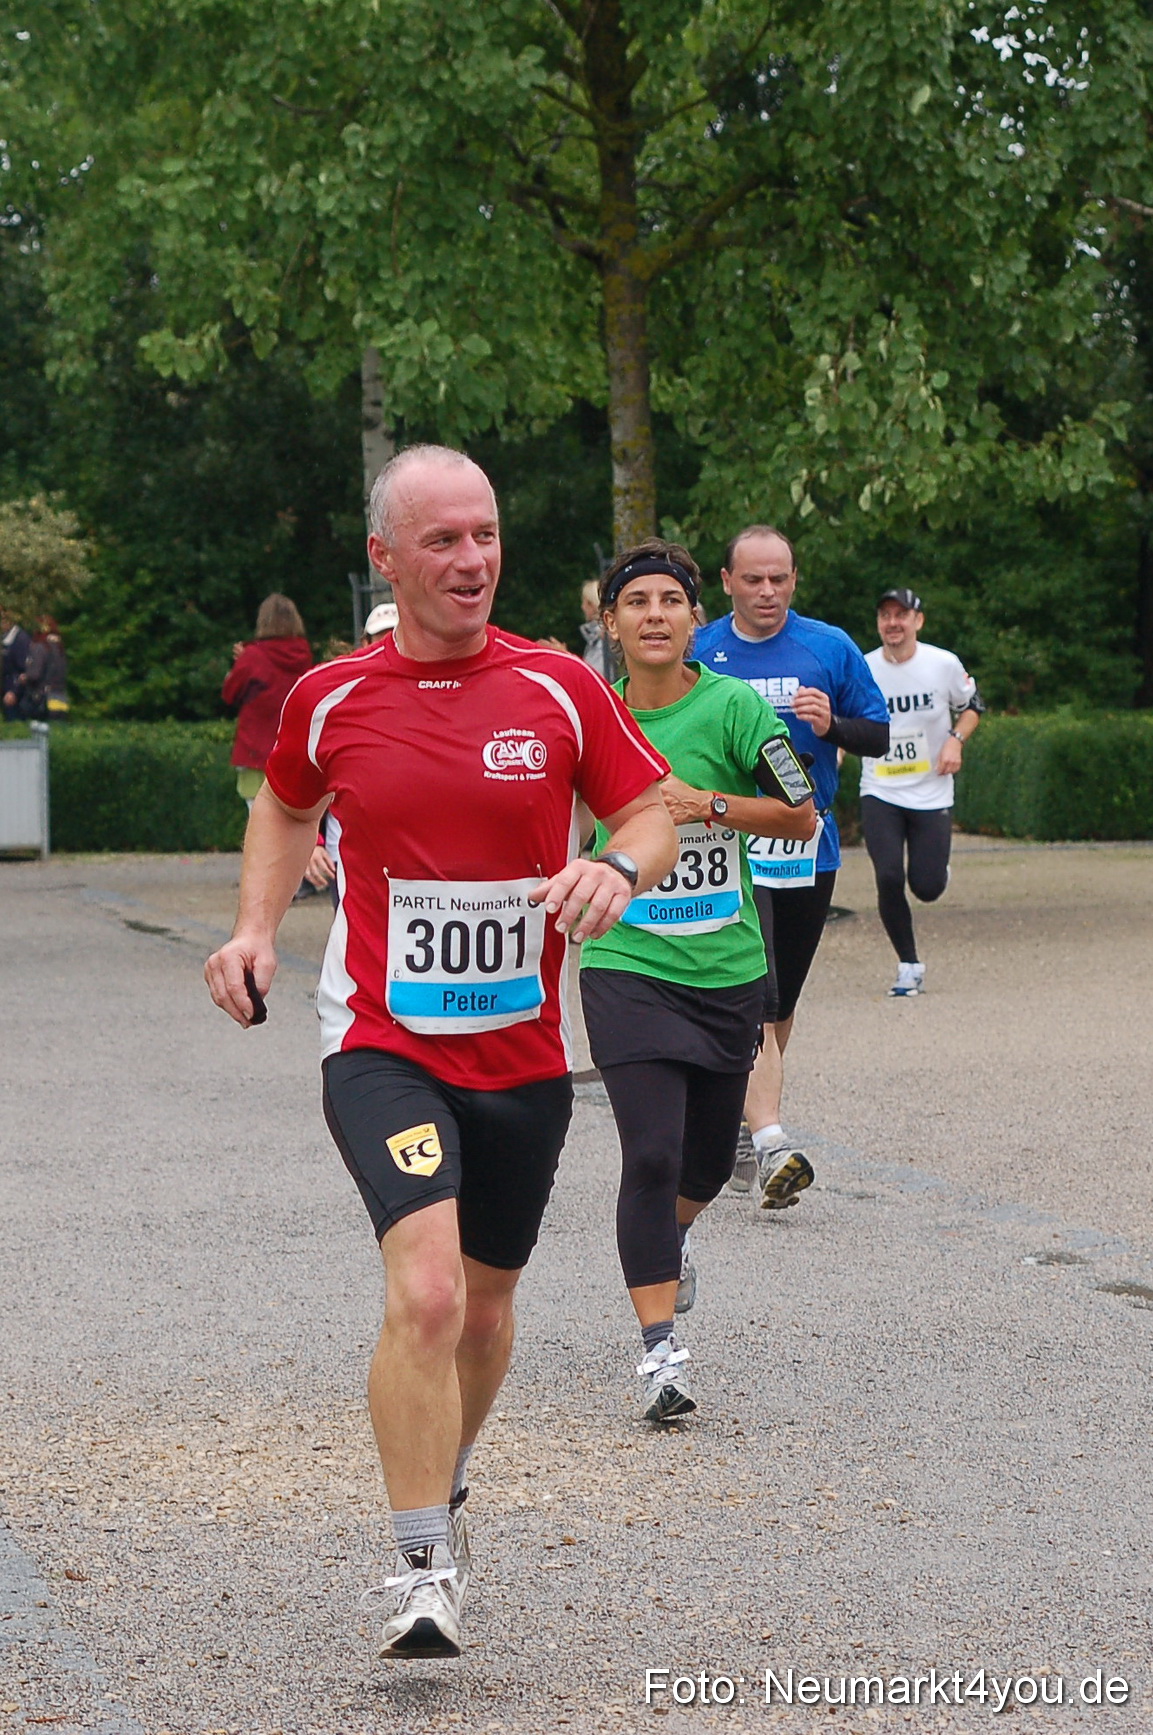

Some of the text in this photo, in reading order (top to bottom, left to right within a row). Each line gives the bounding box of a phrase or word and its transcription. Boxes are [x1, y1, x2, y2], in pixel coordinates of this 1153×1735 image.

[418, 680, 452, 689] CRAFT
[493, 728, 535, 739] Laufteam
[499, 740, 524, 758] ASV
[755, 864, 800, 876] Bernhard
[393, 895, 522, 911] PARTL Neumarkt
[648, 902, 713, 921] Cornelia
[405, 916, 526, 975] 3001
[443, 990, 498, 1012] Peter
[399, 1138, 437, 1168] FC
